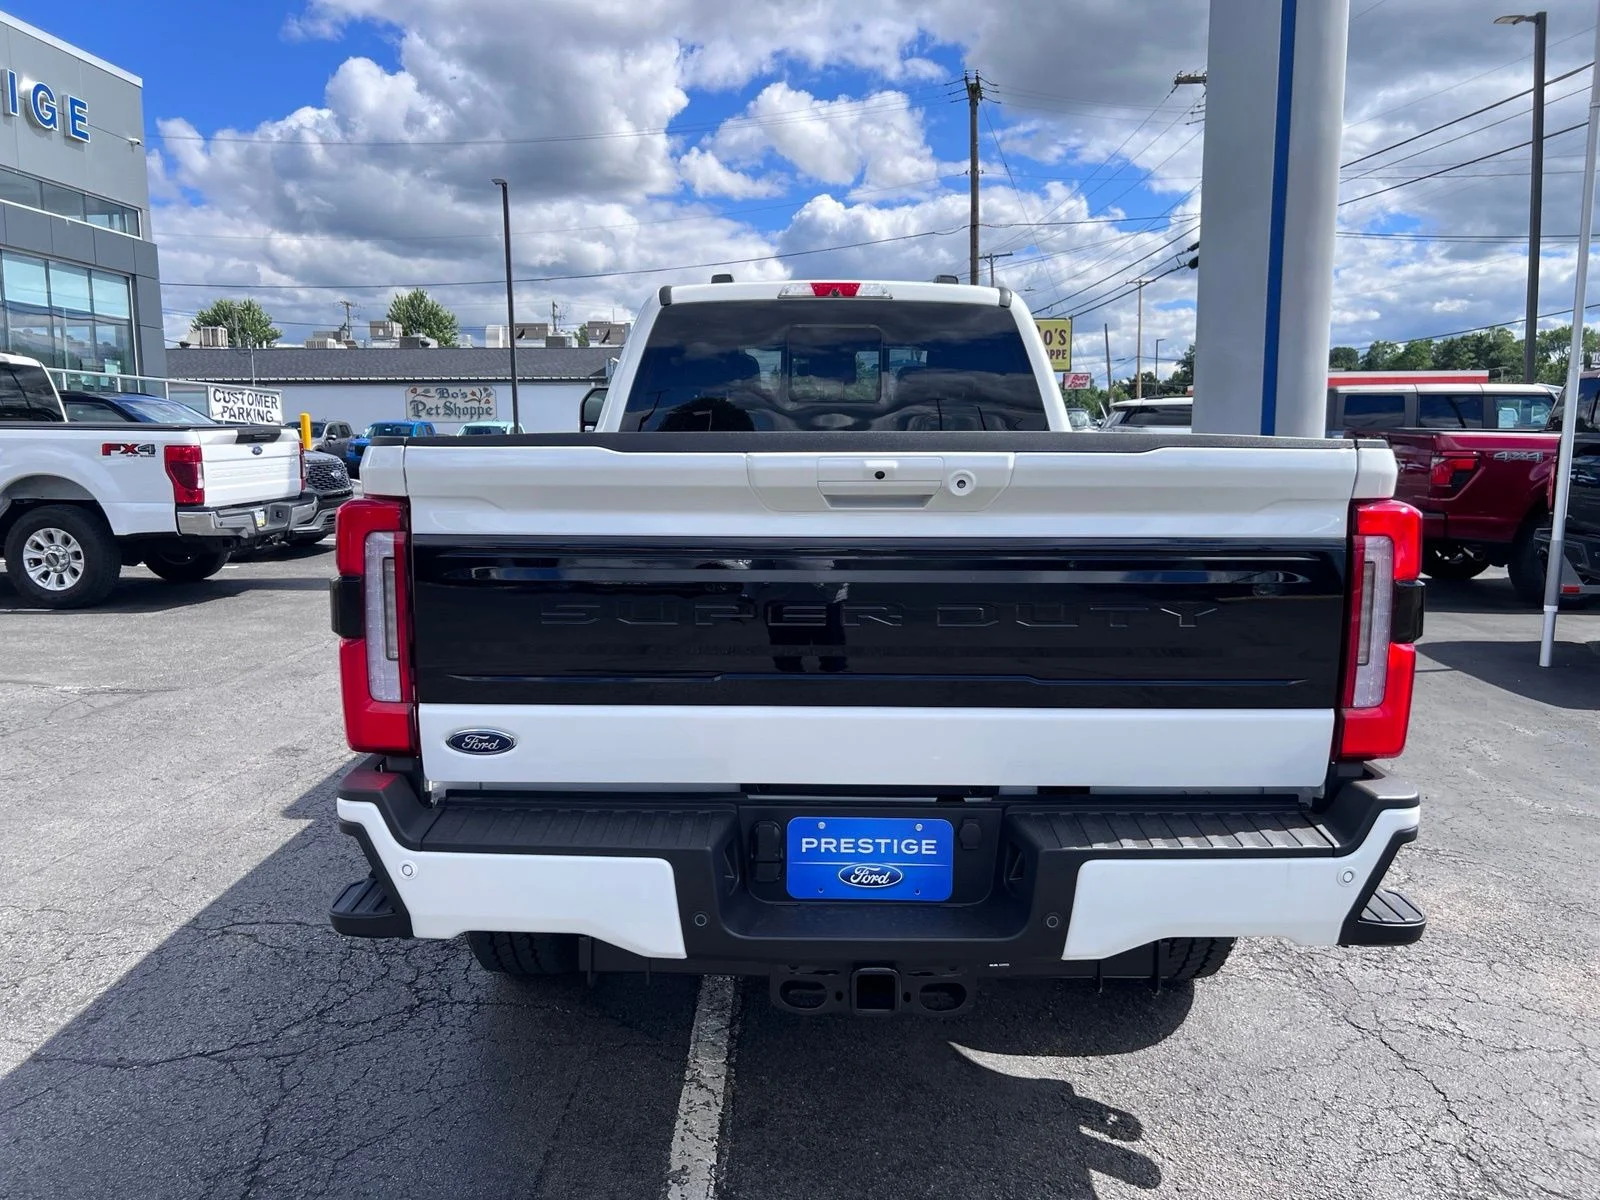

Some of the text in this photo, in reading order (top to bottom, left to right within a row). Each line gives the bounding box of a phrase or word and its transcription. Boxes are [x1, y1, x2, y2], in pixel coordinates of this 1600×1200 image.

[2, 68, 91, 143] IGE
[213, 388, 279, 410] CUSTOMER
[435, 387, 468, 399] Bo's
[221, 405, 274, 423] PARKING
[410, 400, 493, 419] Pet Shoppe
[101, 443, 156, 456] FX4
[540, 600, 1218, 628] SUPER DUTY
[461, 734, 500, 751] Ford
[801, 837, 937, 855] PRESTIGE
[849, 863, 892, 885] Ford
